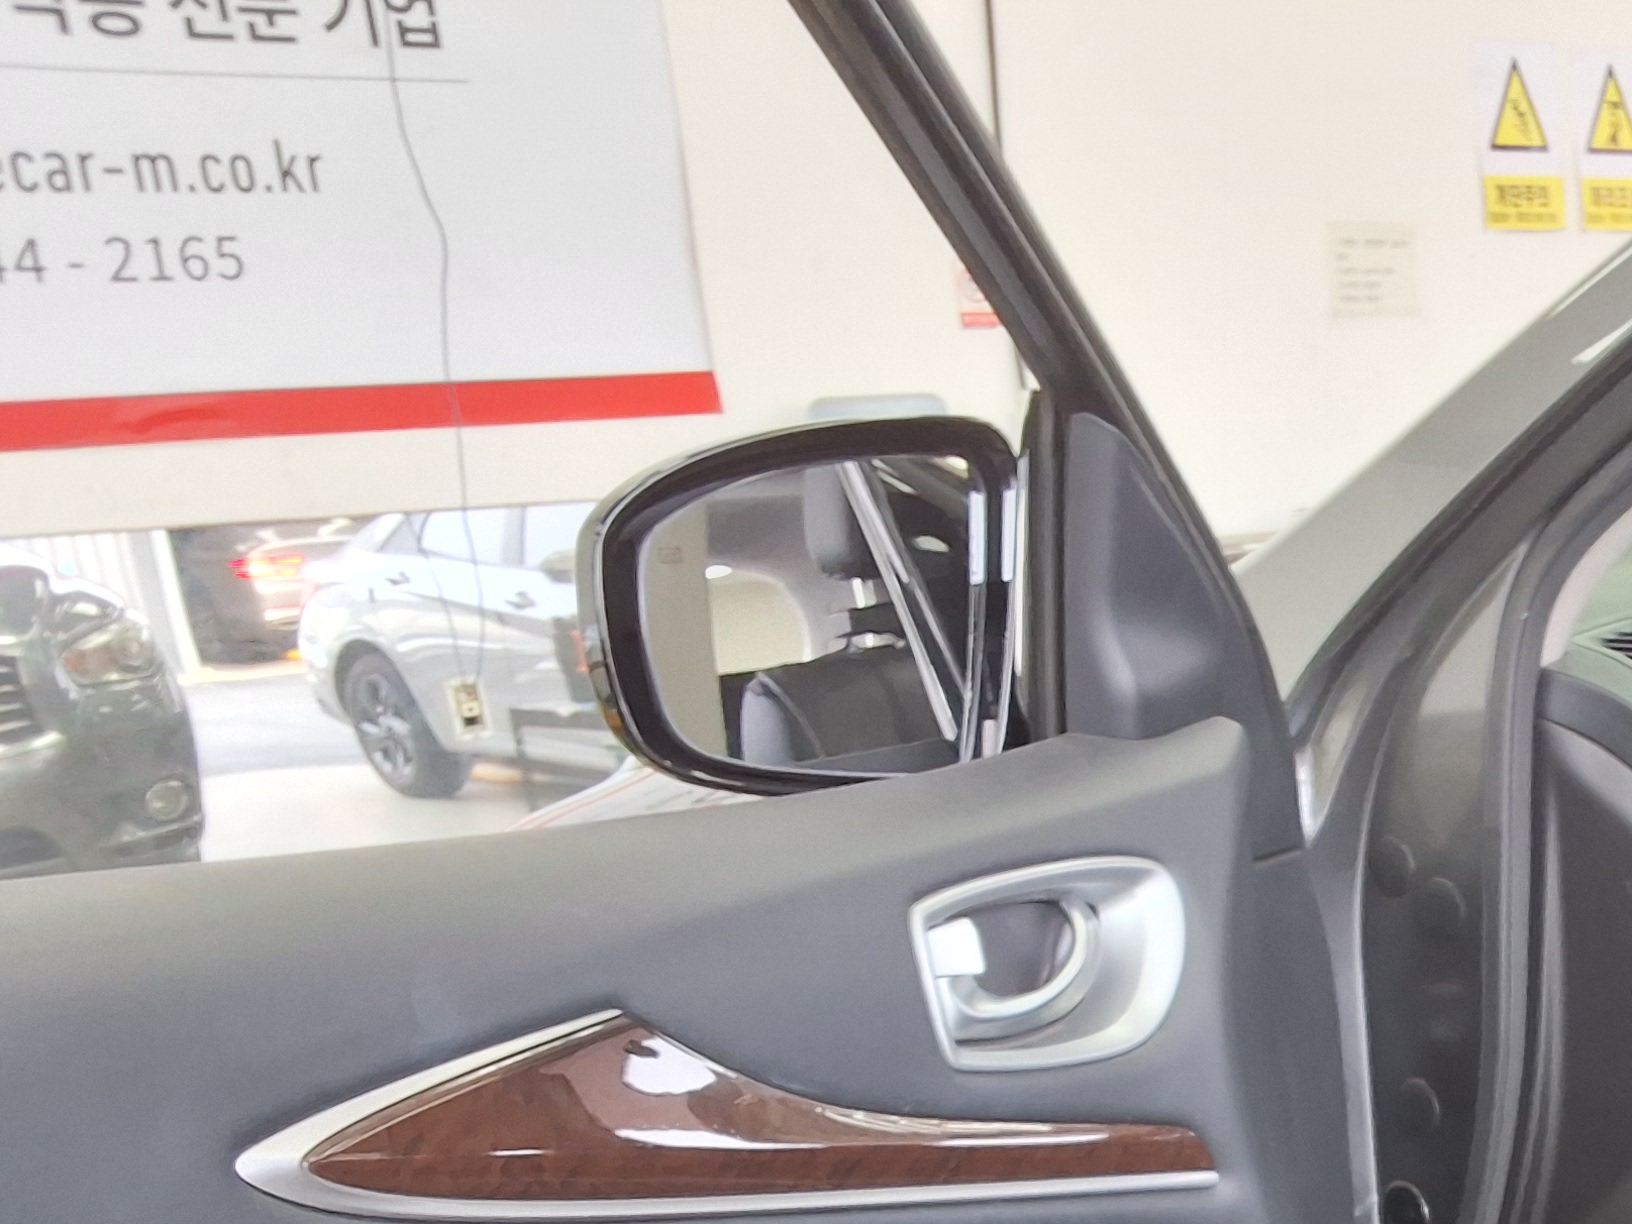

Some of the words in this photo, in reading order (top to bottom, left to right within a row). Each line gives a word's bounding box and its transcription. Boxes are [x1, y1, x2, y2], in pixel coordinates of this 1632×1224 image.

[0, 138, 321, 194] car-m.co.kr
[0, 237, 47, 283] 4
[104, 235, 245, 282] 2165
